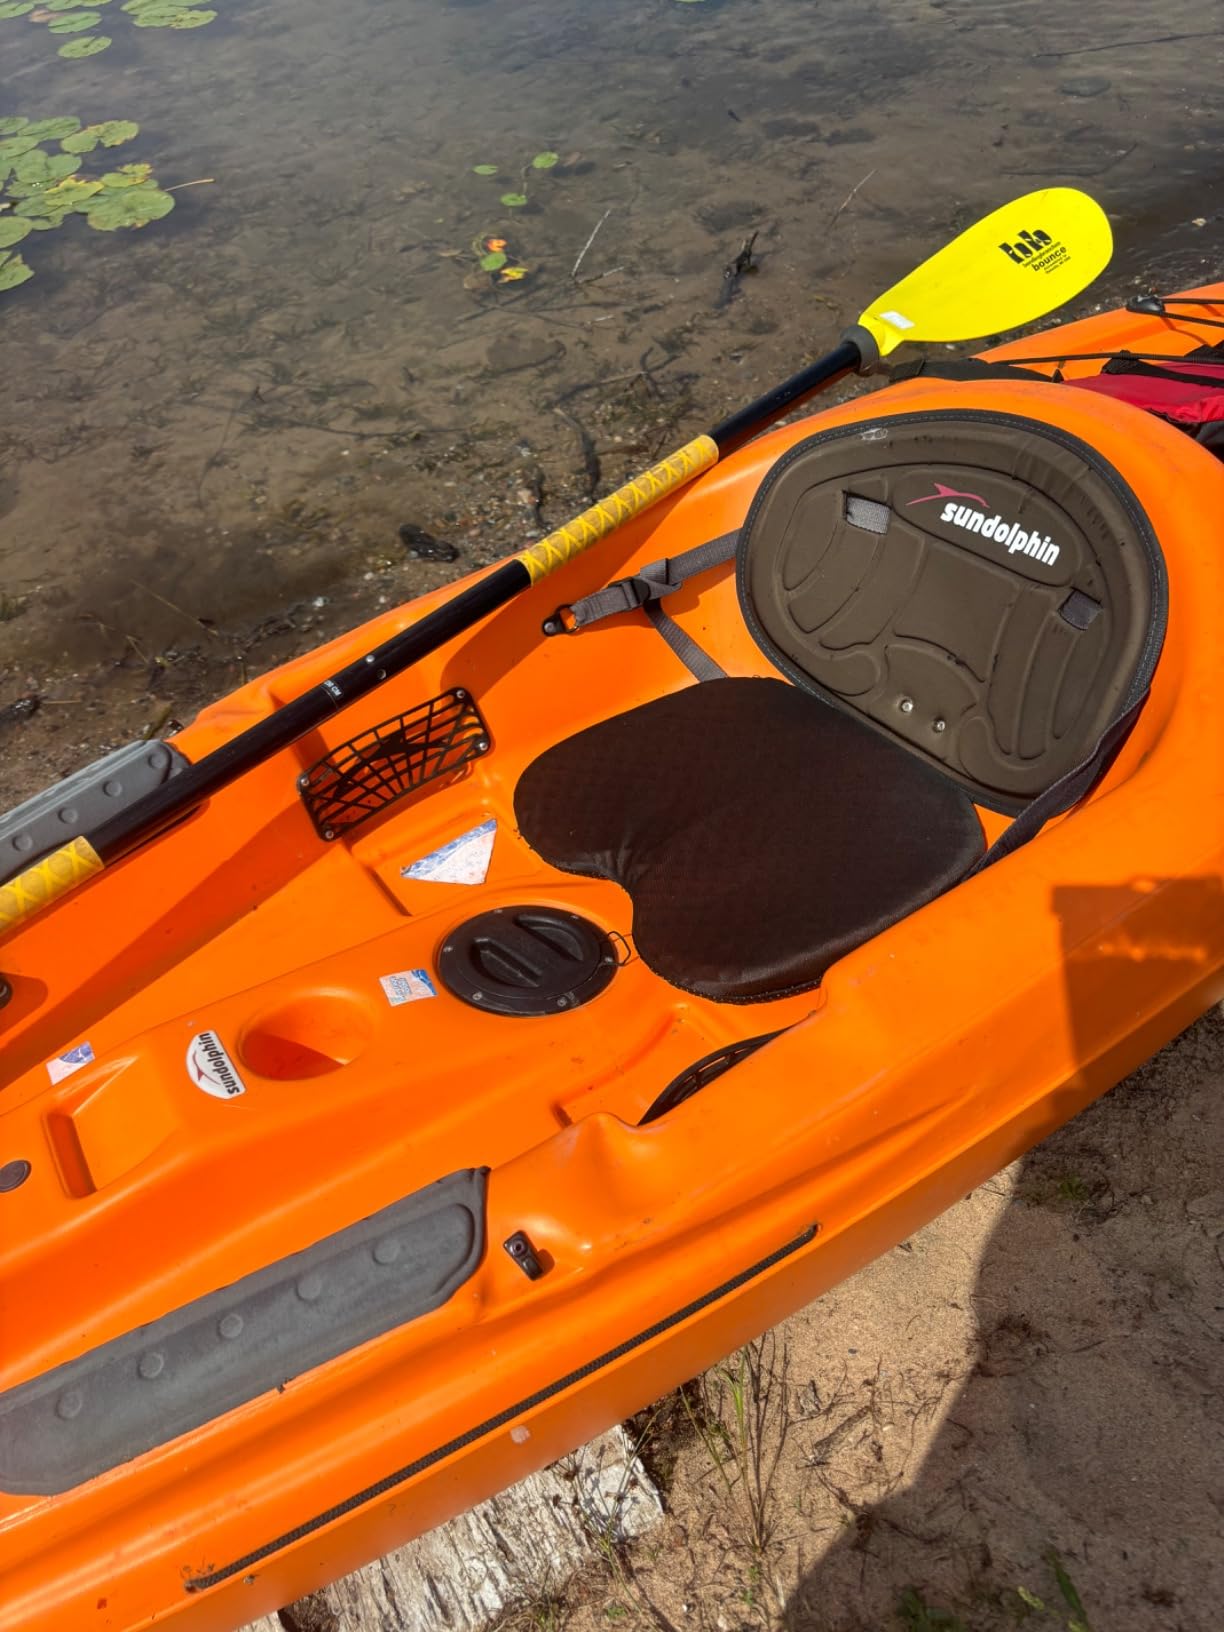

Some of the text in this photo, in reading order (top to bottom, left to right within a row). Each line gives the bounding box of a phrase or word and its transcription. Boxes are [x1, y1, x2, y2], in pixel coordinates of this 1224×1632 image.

[1031, 246, 1067, 271] bounce
[940, 502, 1061, 566] sundolphin
[198, 1032, 240, 1094] sundolphin
